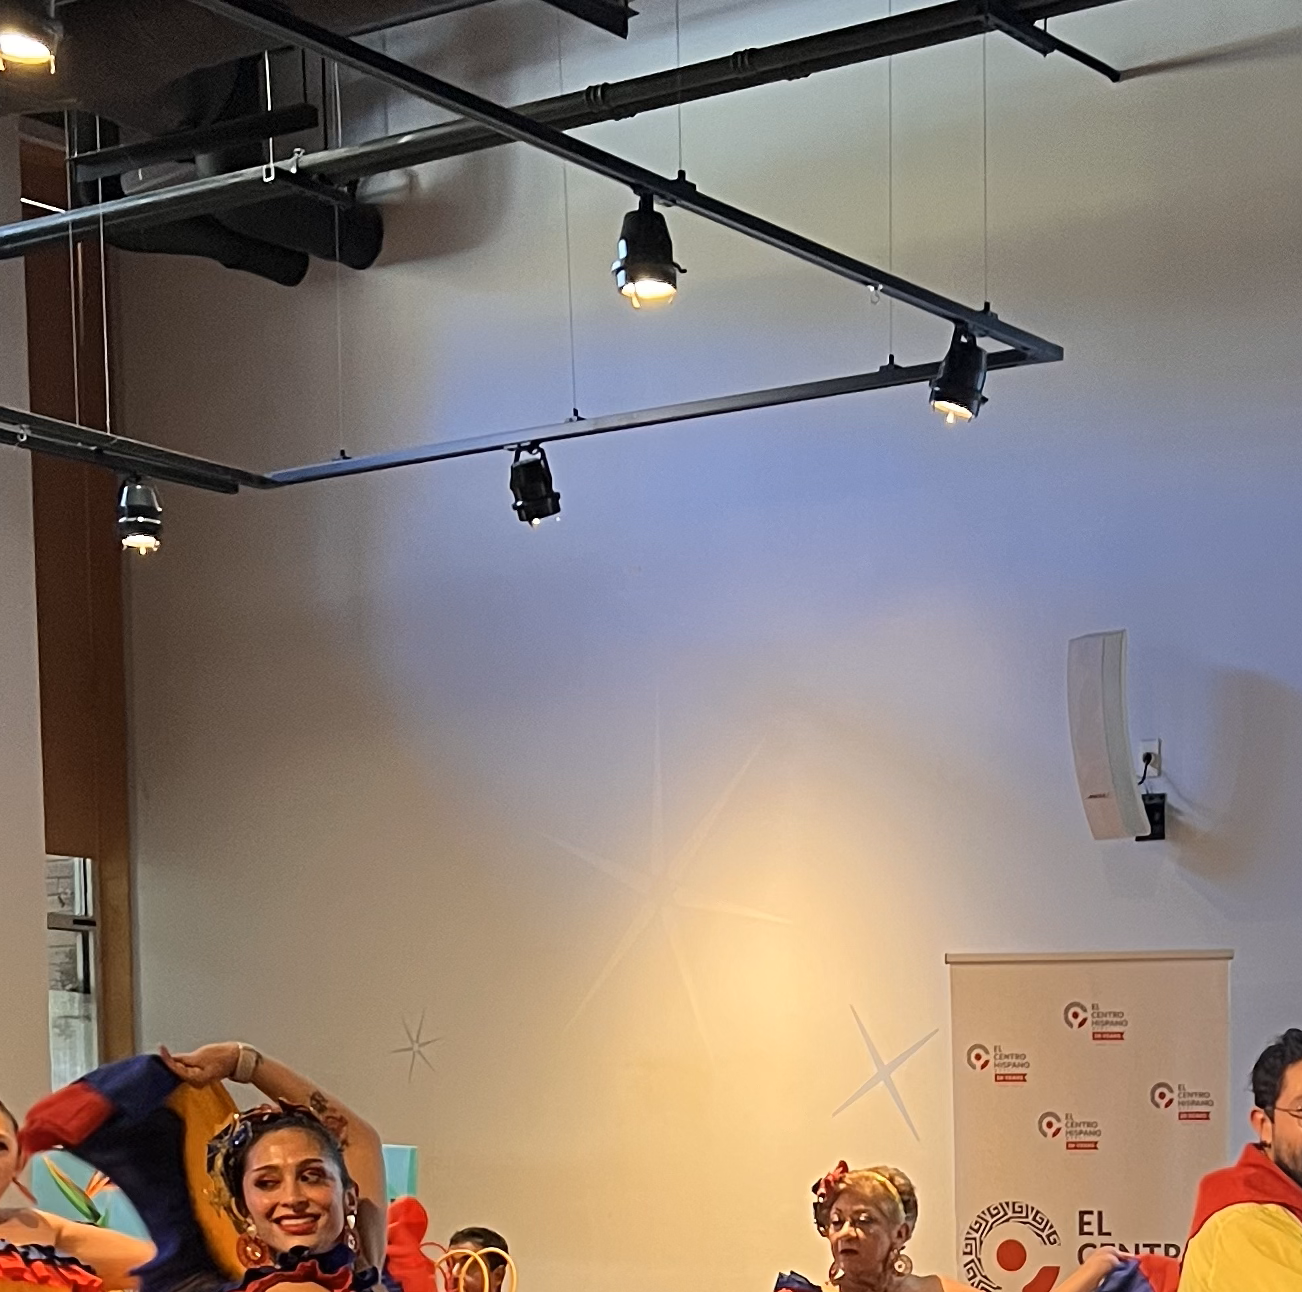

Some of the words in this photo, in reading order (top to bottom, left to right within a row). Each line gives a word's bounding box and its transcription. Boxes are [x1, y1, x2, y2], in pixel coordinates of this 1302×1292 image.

[1091, 1011, 1125, 1019] CENTRO
[1178, 1091, 1211, 1099] CENTRO
[1065, 1120, 1099, 1128] CENTRO
[1078, 1210, 1112, 1237] EL
